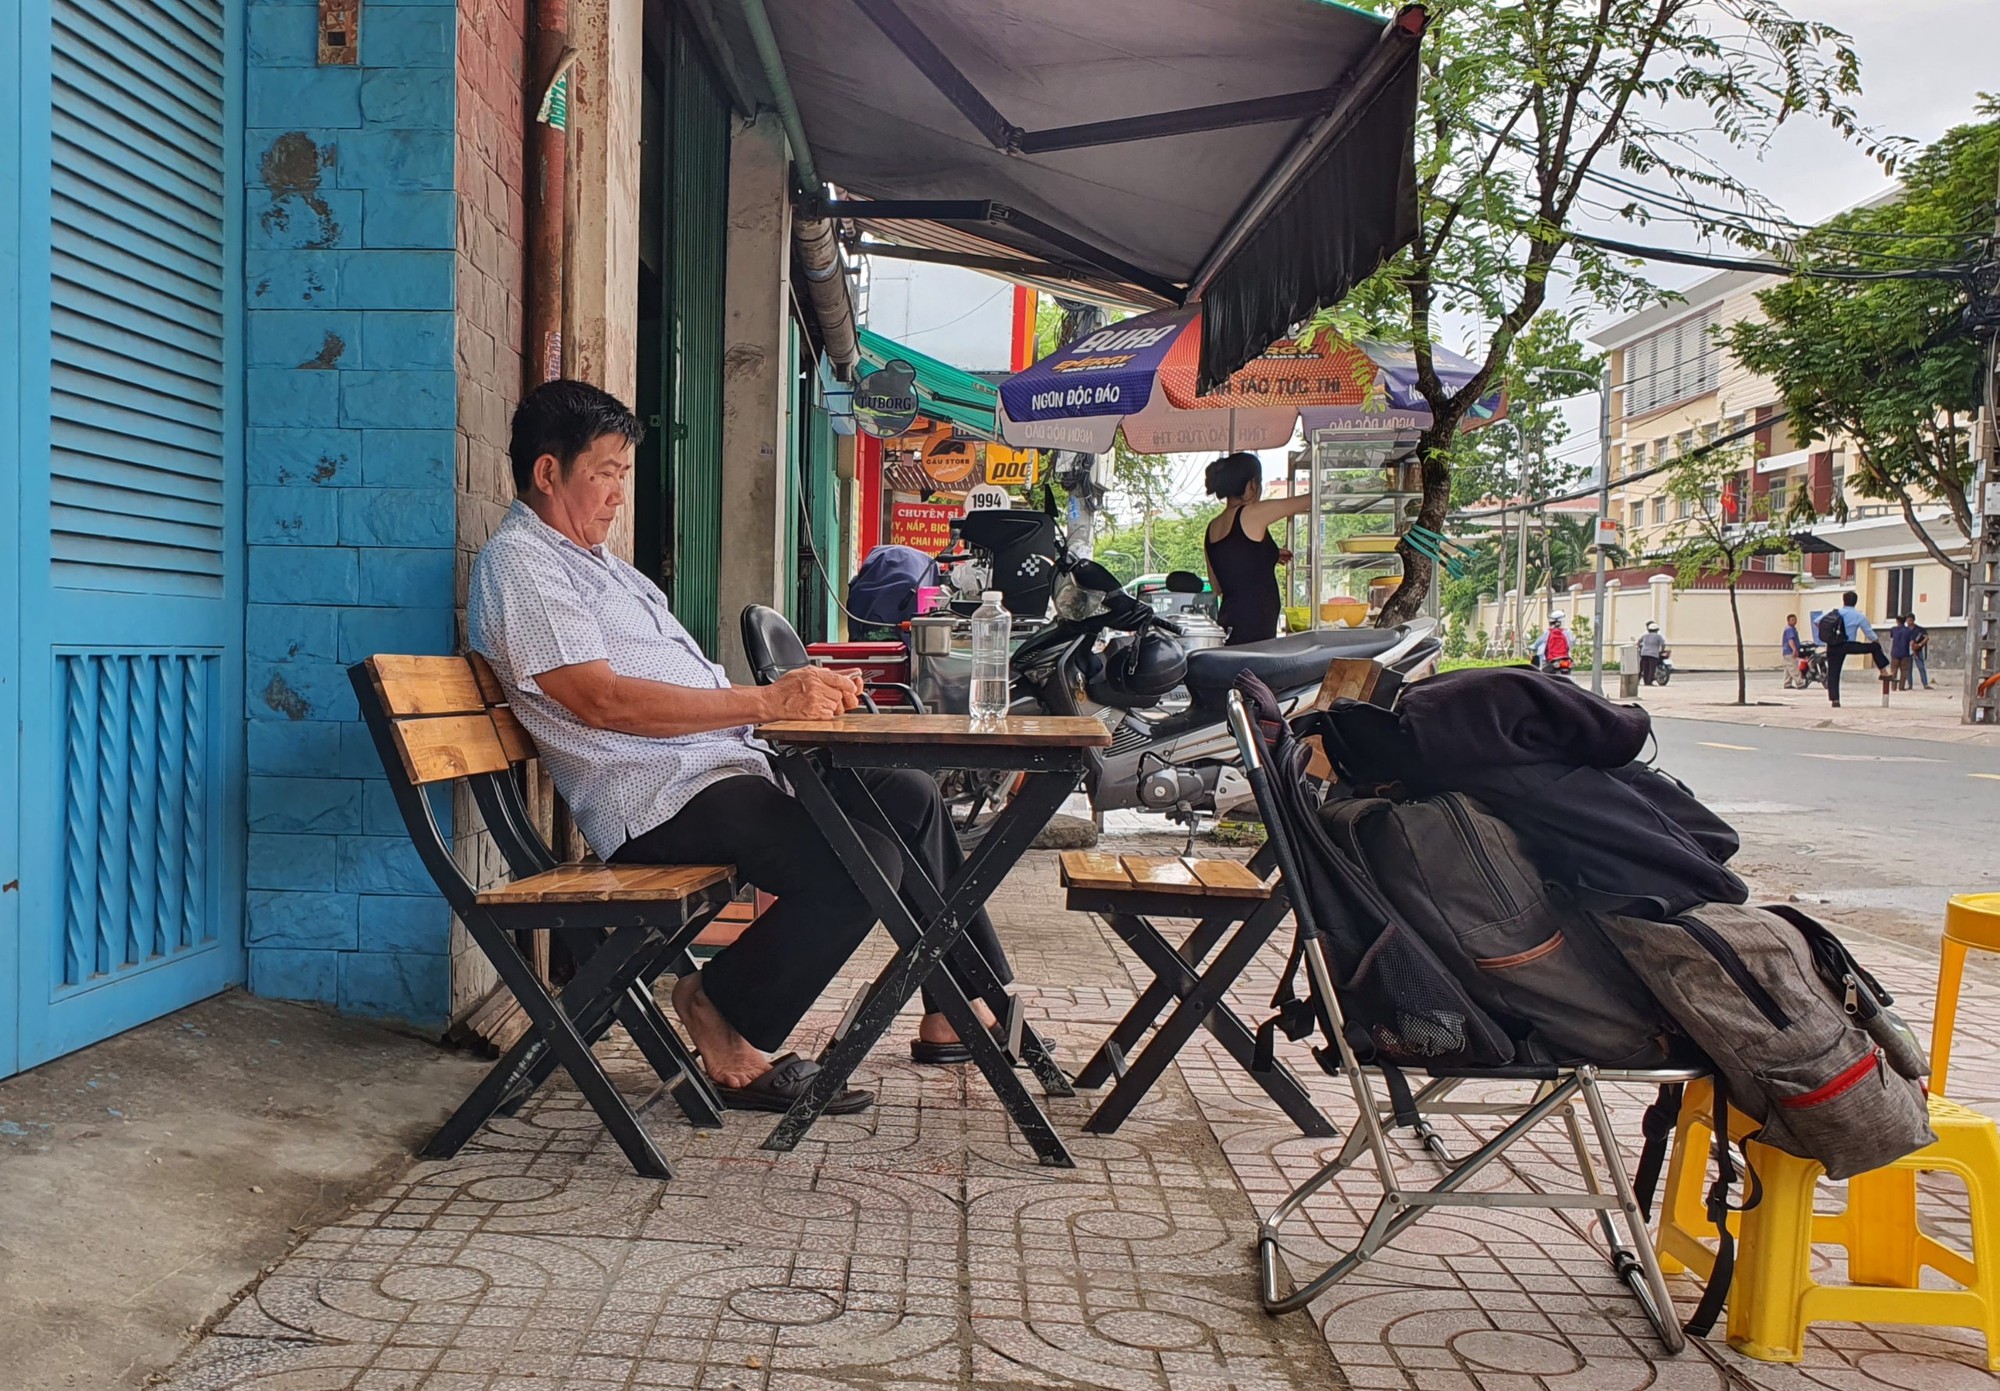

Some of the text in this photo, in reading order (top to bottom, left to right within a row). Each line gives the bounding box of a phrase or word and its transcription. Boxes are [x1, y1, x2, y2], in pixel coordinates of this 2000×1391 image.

[859, 396, 911, 410] TUBORG
[1067, 385, 1093, 409] ĐỘC
[1095, 383, 1120, 403] ĐÁO
[972, 493, 1002, 508] 1994
[898, 507, 945, 519] CHUYÊN
[910, 537, 931, 546] CHAI
